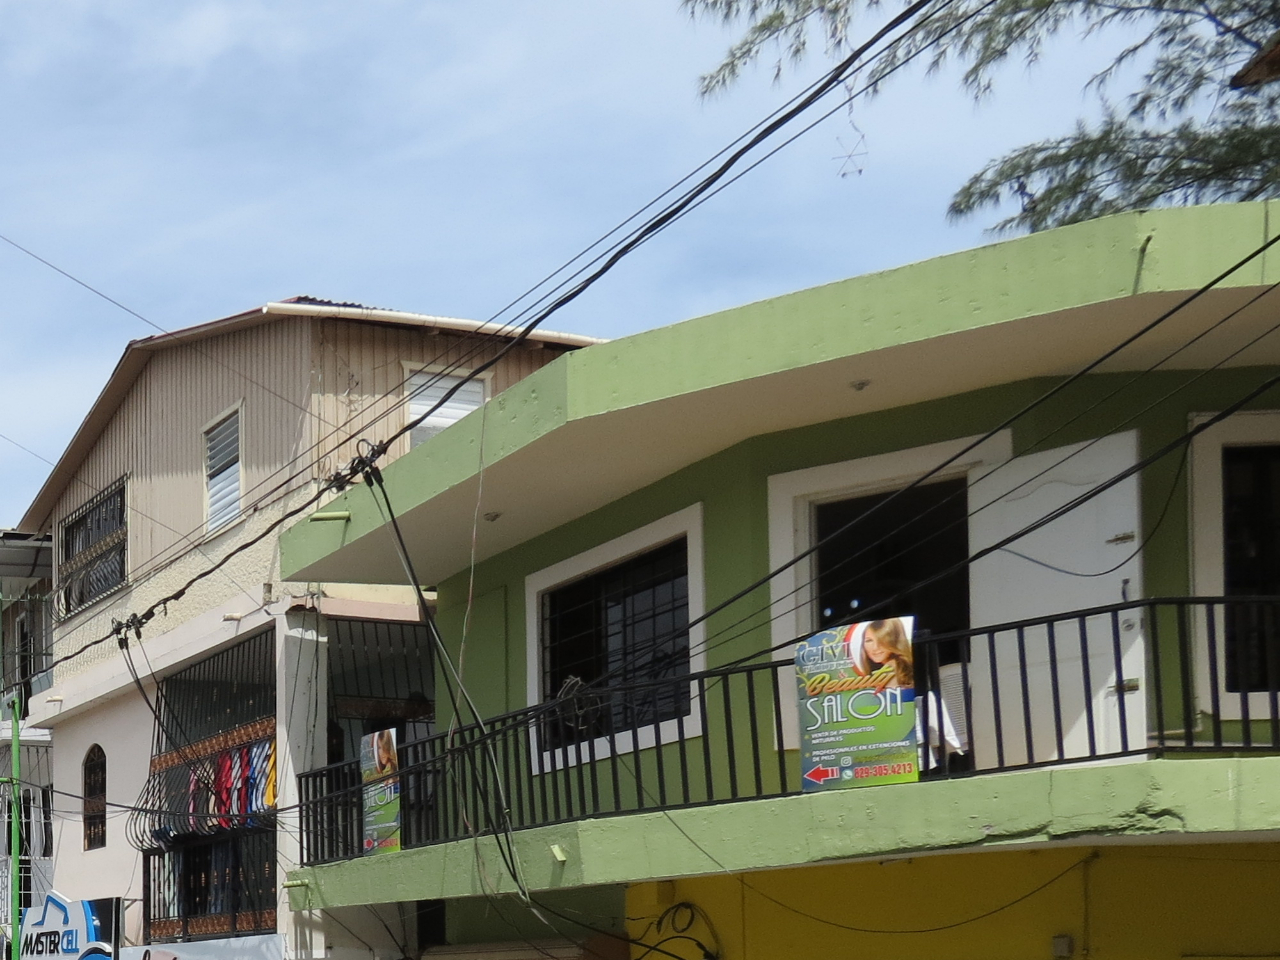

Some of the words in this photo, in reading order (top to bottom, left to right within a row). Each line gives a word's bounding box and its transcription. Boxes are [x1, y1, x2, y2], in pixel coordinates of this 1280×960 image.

[806, 664, 895, 696] Beauty
[806, 687, 903, 731] SALON
[21, 930, 60, 956] MASTER
